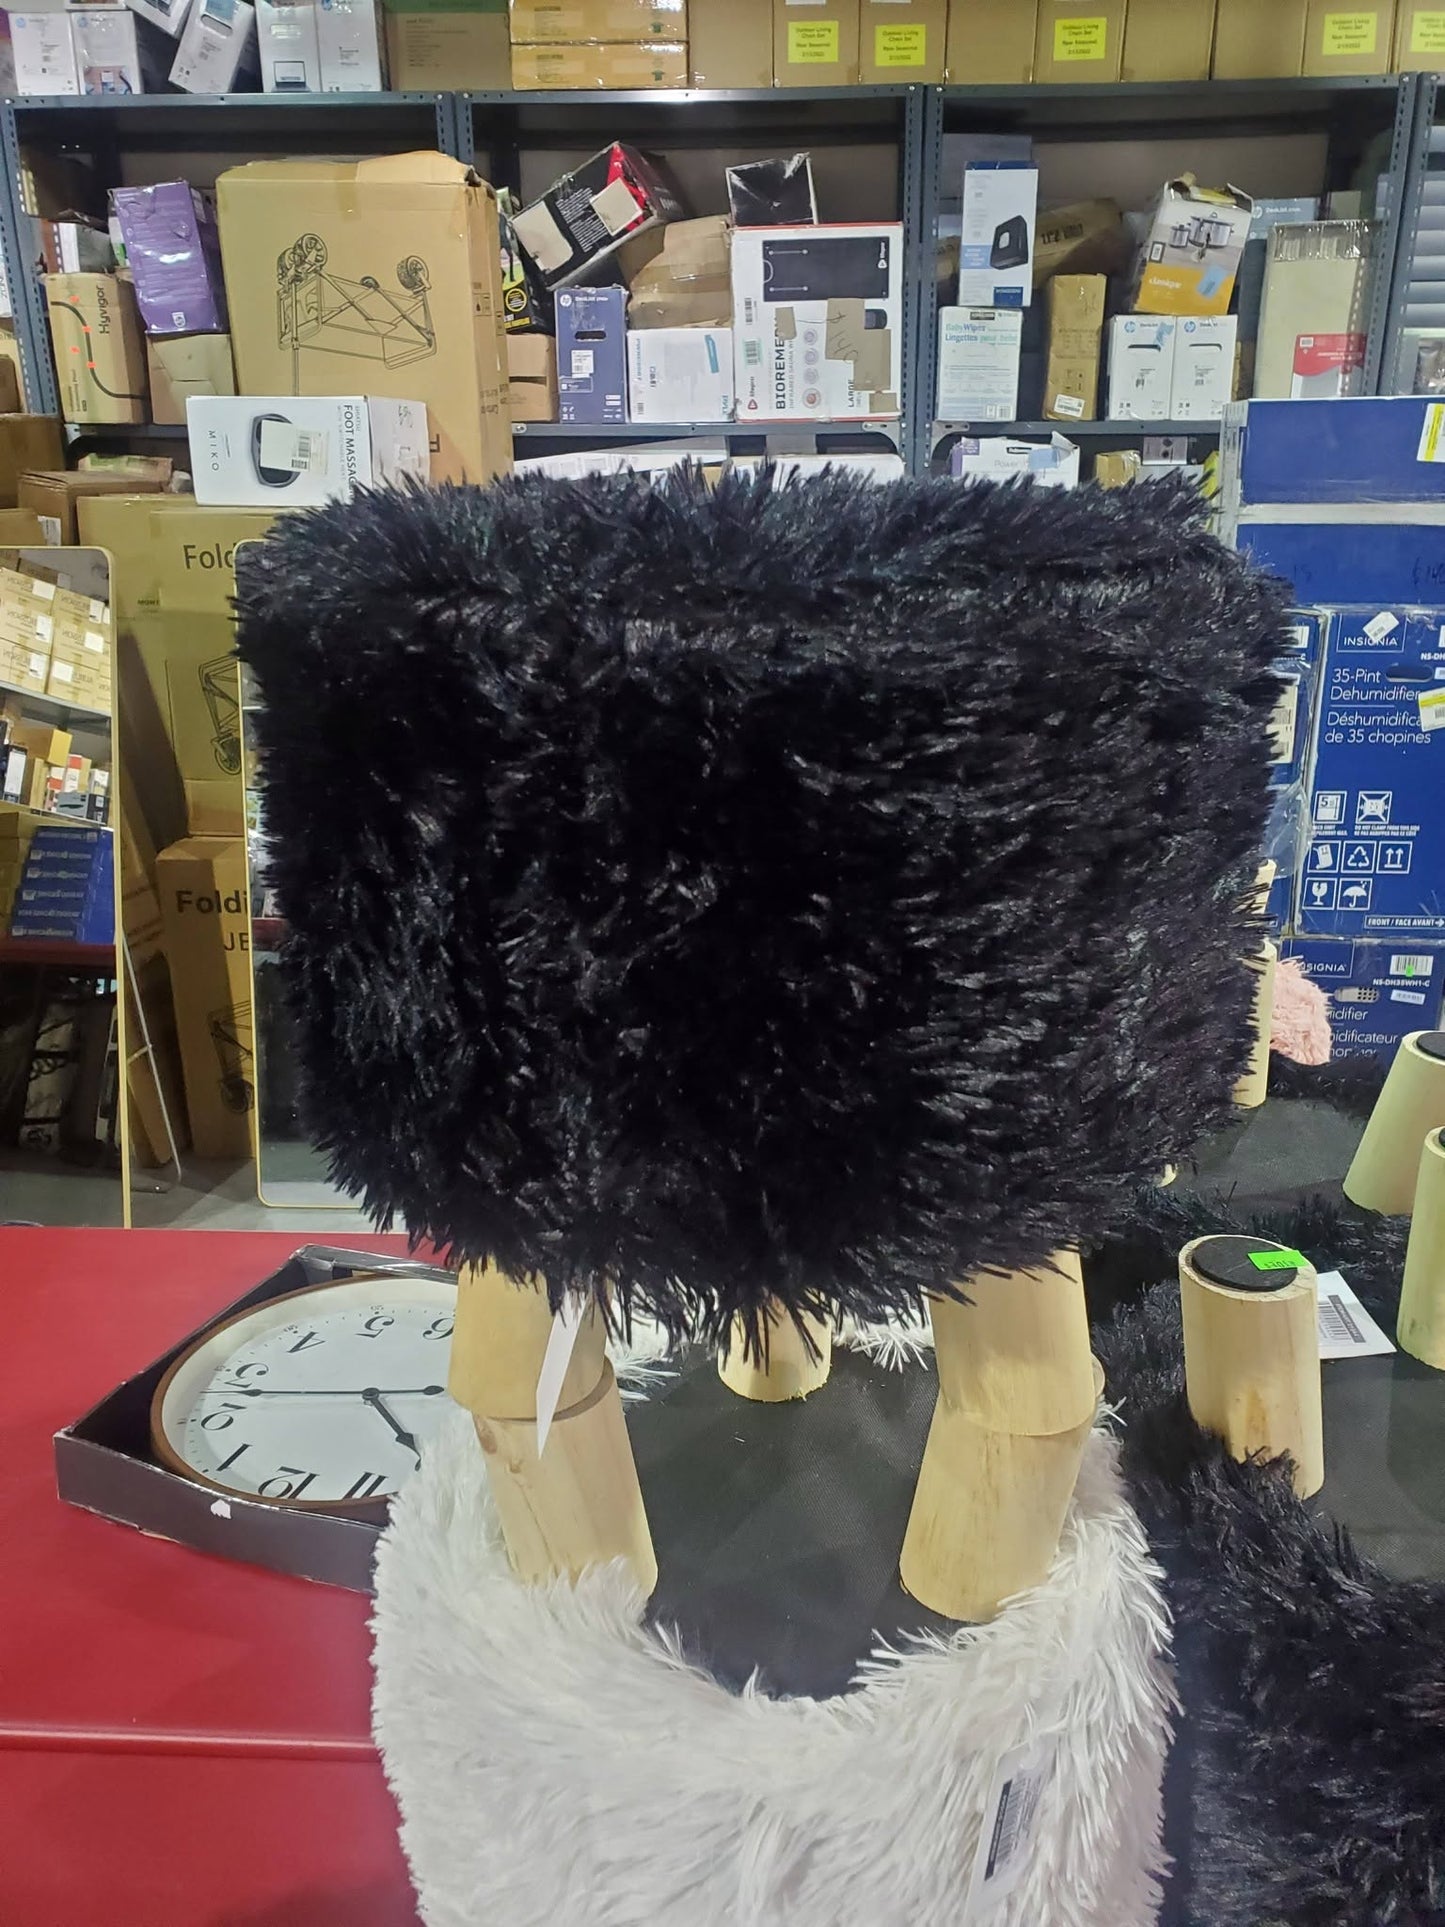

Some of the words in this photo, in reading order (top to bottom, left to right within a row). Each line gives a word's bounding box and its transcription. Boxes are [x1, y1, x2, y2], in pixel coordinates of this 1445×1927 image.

[95, 285, 111, 334] Hyvigor
[344, 404, 354, 435] FOOT
[207, 429, 220, 472] MIKO
[1332, 667, 1381, 683] 35-Pint
[1330, 685, 1420, 701] Dehumidifier
[1327, 710, 1421, 726] Déshumidifica
[1325, 728, 1344, 743] de
[1347, 728, 1365, 743] 35
[1368, 728, 1431, 747] chopines
[1368, 917, 1390, 926] FRONT
[1395, 918, 1411, 926] FACE
[1411, 918, 1436, 927] AVANT
[355, 1315, 395, 1339] 5
[286, 1331, 326, 1354] 4
[224, 1362, 270, 1389] 3
[200, 1402, 248, 1432] 2
[216, 1443, 253, 1472] 1
[257, 1466, 321, 1500] 12
[342, 1471, 389, 1500] 11
